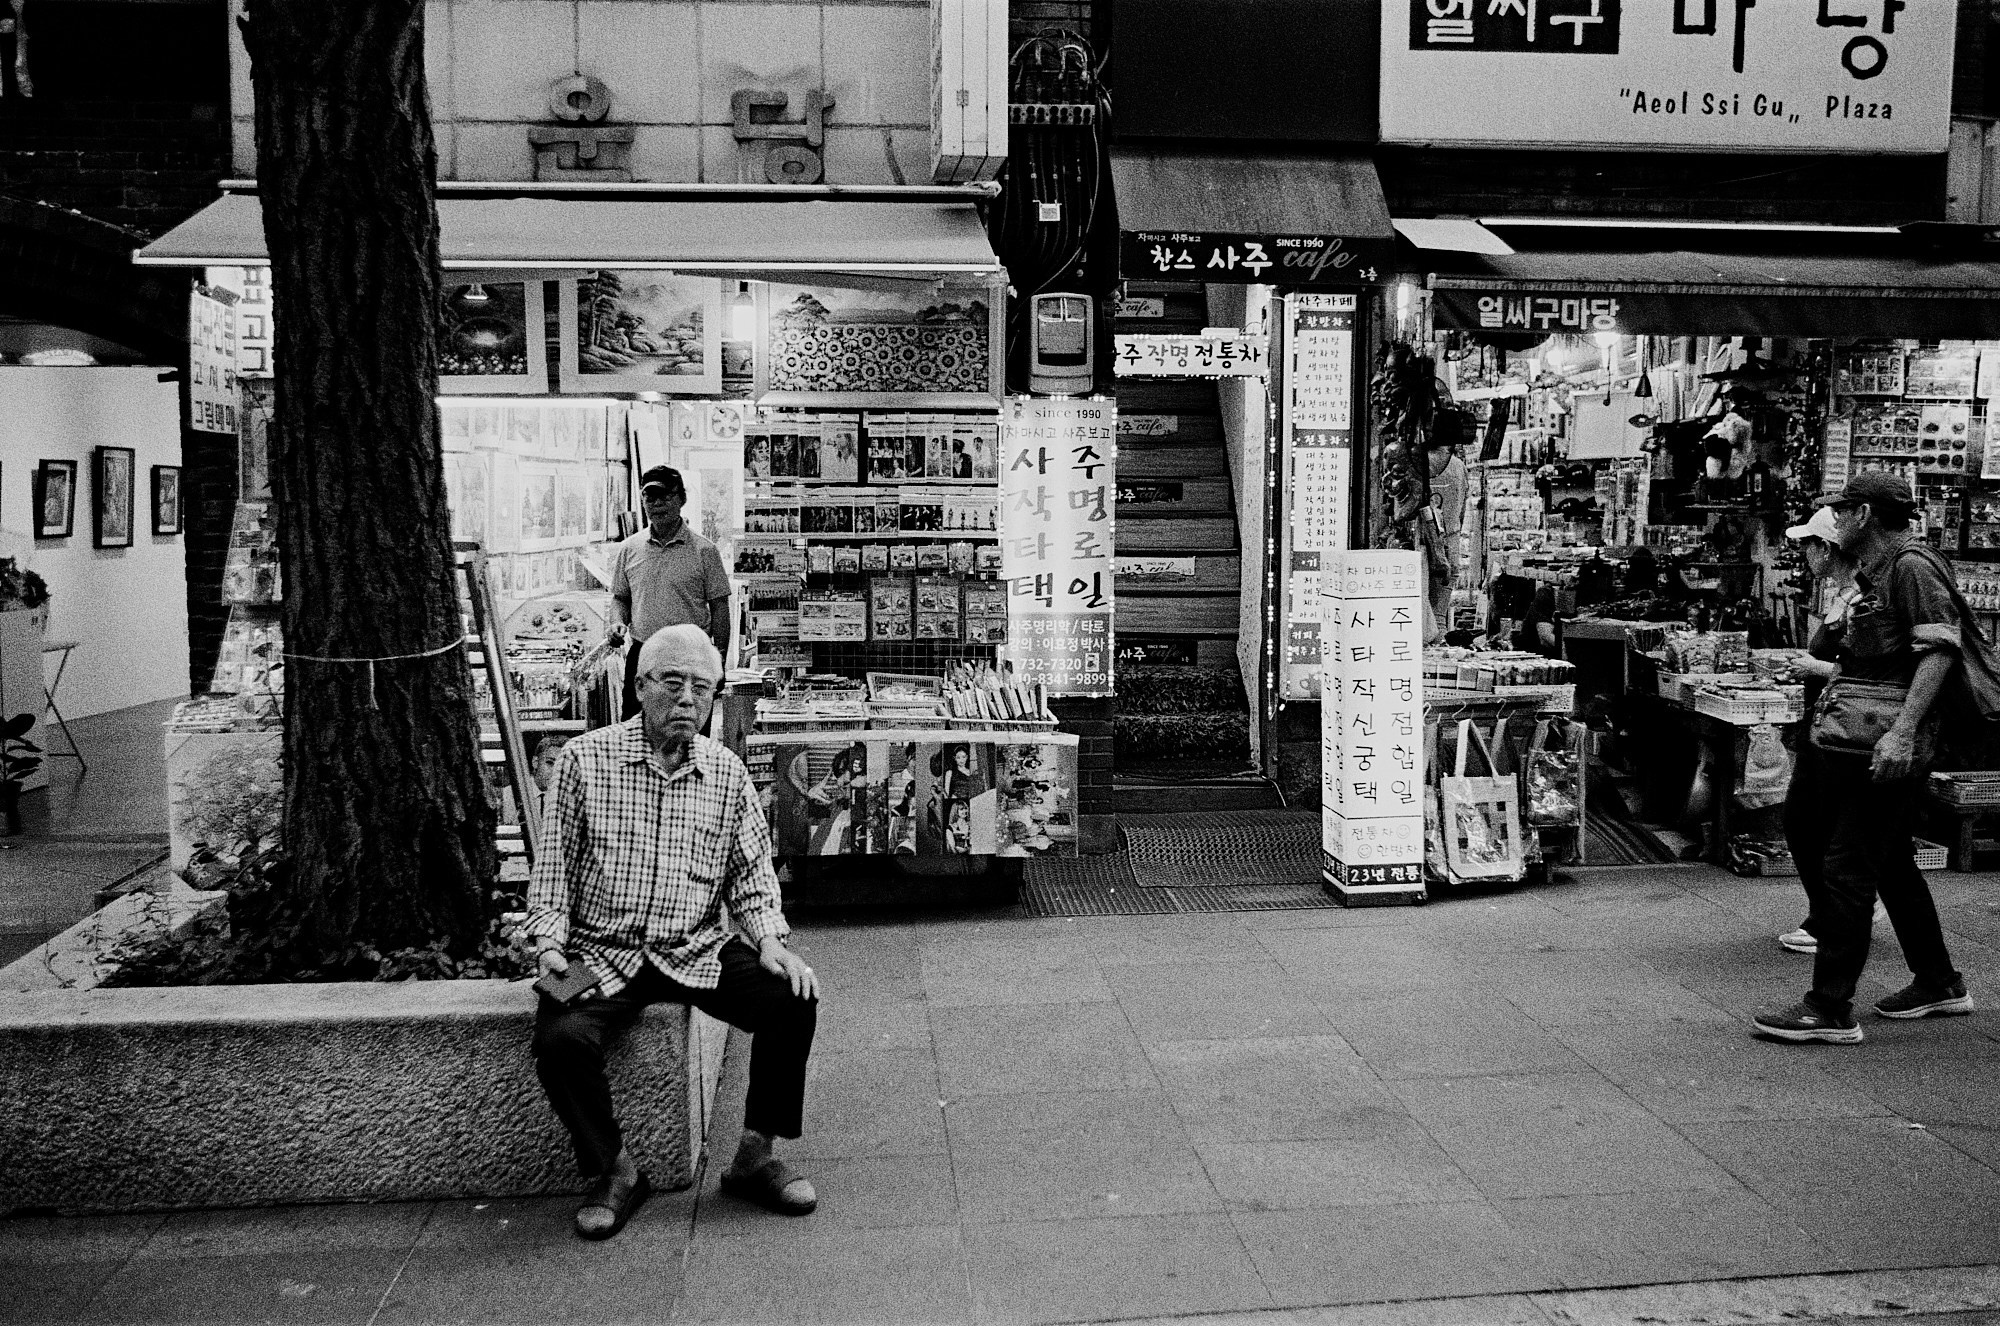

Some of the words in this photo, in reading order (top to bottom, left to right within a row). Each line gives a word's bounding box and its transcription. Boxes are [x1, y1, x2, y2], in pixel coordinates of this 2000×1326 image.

[1701, 92, 1739, 115] Ssi
[1826, 95, 1893, 120] Plaza
[1276, 238, 1301, 248] SINCE
[1303, 238, 1324, 248] 1990
[1150, 244, 1196, 272] 찬스
[1206, 242, 1273, 277] 사주
[1283, 238, 1358, 281] cafe
[1358, 266, 1378, 282] 2층
[1298, 295, 1353, 307] 사주카페
[1477, 296, 1620, 330] 얼씨구마당
[1195, 341, 1261, 369] 전통차
[1034, 407, 1072, 418] since
[1076, 409, 1101, 419] 1990
[1007, 571, 1108, 608] 택일
[1081, 619, 1105, 634] 타로
[1350, 607, 1413, 631] 사주
[1081, 637, 1105, 652] 박사
[1350, 640, 1413, 662] 타로
[1352, 677, 1413, 702] 작명
[1352, 780, 1416, 805] 택일
[1350, 868, 1386, 882] 23년
[1390, 865, 1420, 882] 전통
